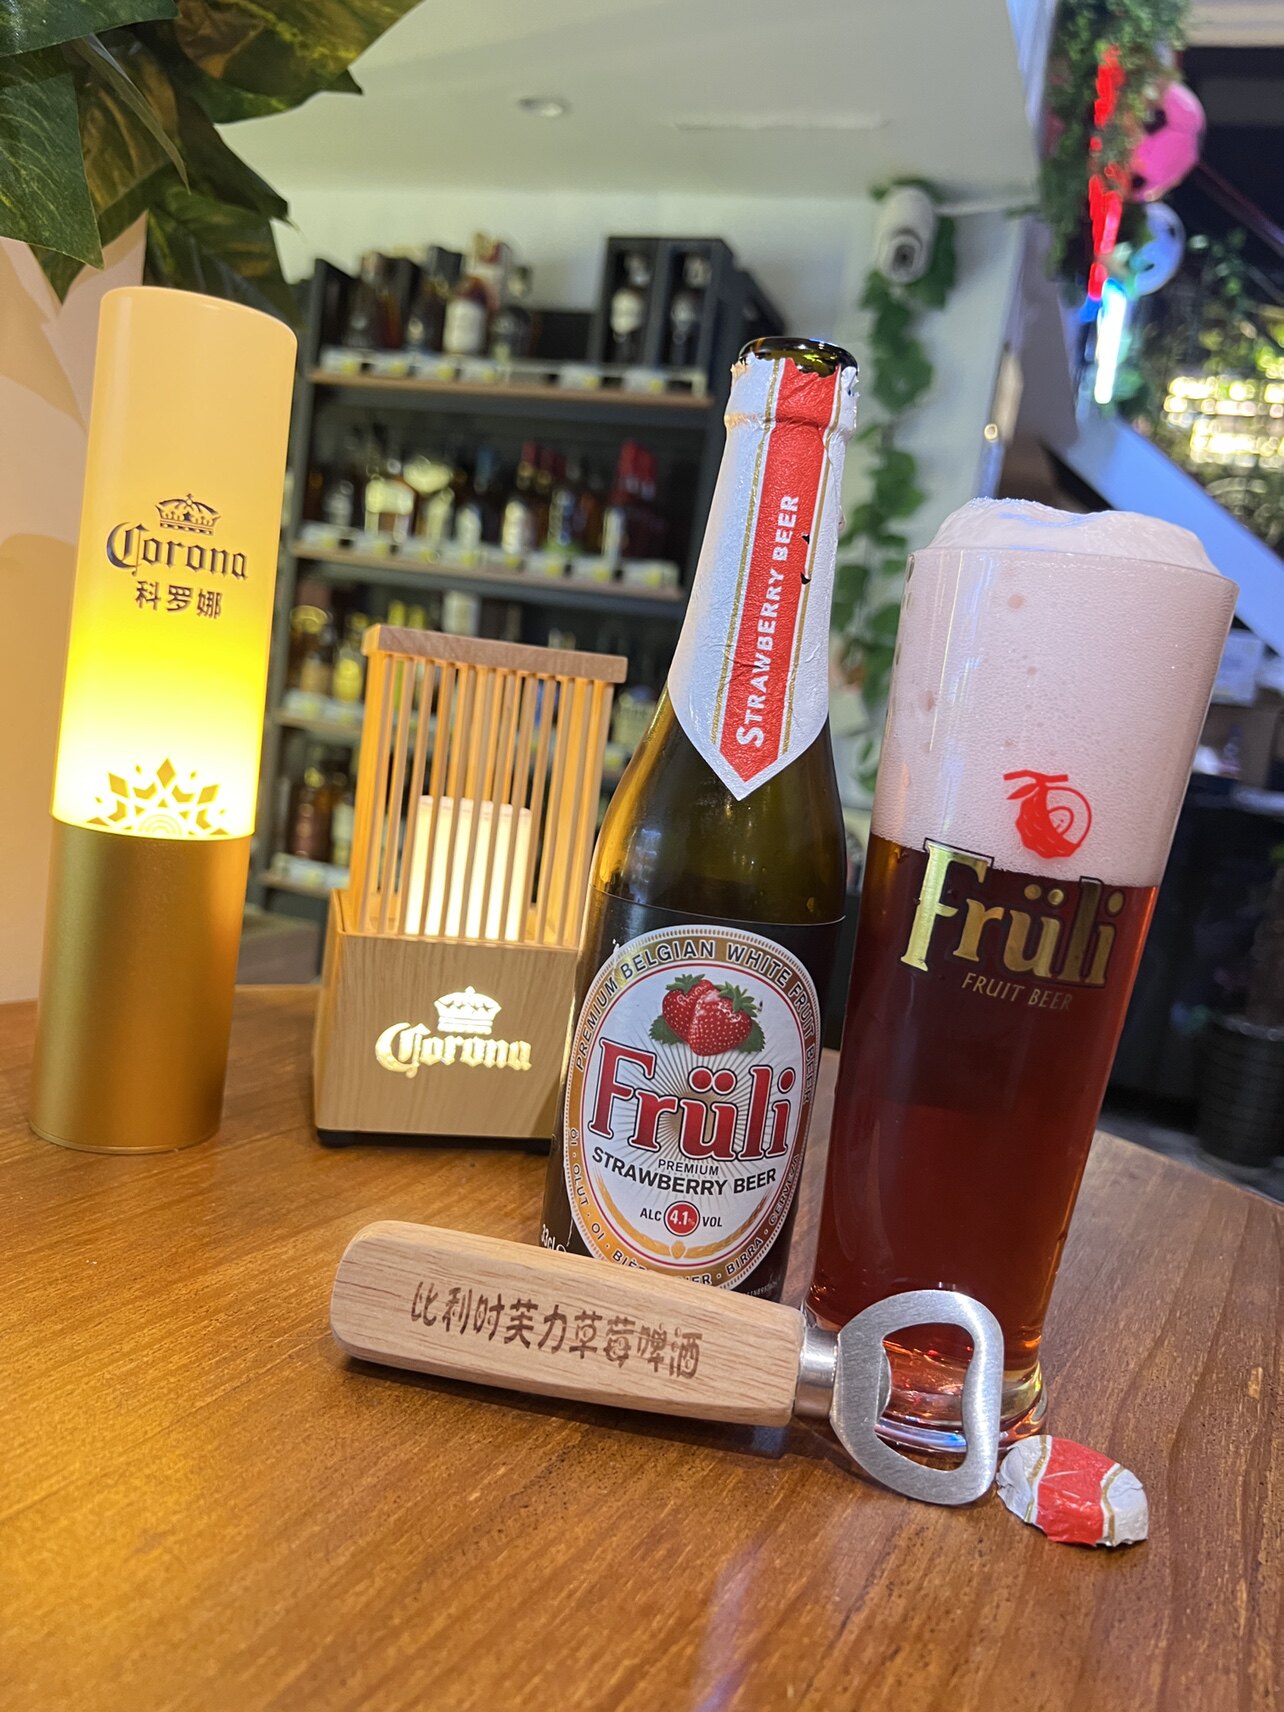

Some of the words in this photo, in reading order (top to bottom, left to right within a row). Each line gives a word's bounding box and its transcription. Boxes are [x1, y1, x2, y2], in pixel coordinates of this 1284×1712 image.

[105, 521, 248, 580] Corona
[135, 580, 223, 619] 科罗娜
[736, 566, 785, 748] STRAWBERRY
[772, 495, 799, 561] BEER
[901, 838, 1124, 988] Früli
[575, 976, 619, 1071] PREMIUM
[619, 940, 715, 980] BELGIAN
[727, 943, 791, 988] WHITE
[788, 983, 816, 1039] FRUIT
[961, 972, 1025, 1002] FRUIT
[1029, 988, 1074, 1012] BEER
[375, 1022, 532, 1079] Corona
[588, 1036, 796, 1161] Früli
[592, 1146, 729, 1196] STRAWBERRY
[733, 1168, 776, 1194] BEER
[657, 1159, 719, 1176] PREMIUM
[573, 1164, 589, 1206] OLUT
[726, 1238, 763, 1275] BIRRA
[640, 1207, 662, 1222] ALC
[702, 1216, 723, 1228] VOL
[410, 1280, 704, 1380] 比利时芙力草莓啤酒
